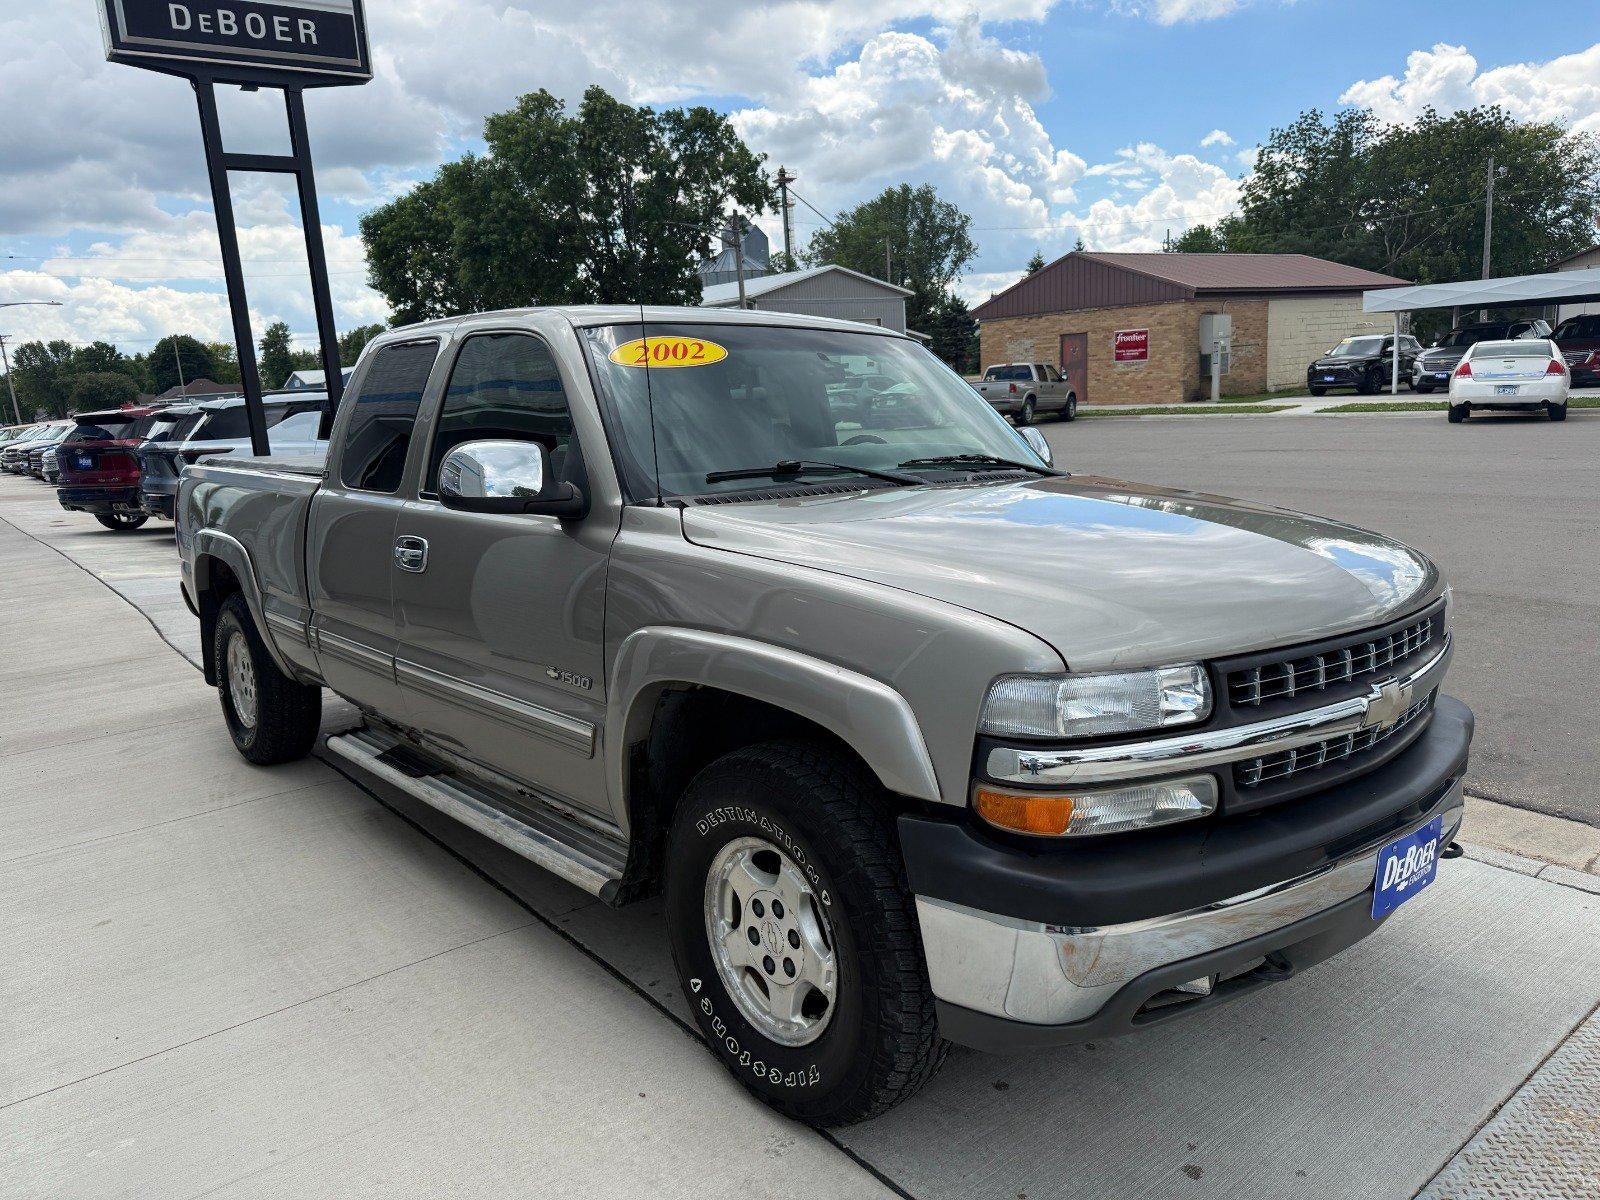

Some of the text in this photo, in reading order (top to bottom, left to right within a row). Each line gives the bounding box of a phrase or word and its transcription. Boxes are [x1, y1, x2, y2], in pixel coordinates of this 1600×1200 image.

[634, 342, 706, 363] 2002
[561, 671, 590, 690] 1500
[696, 806, 819, 885] DESTINATION
[701, 997, 820, 1087] Firestone
